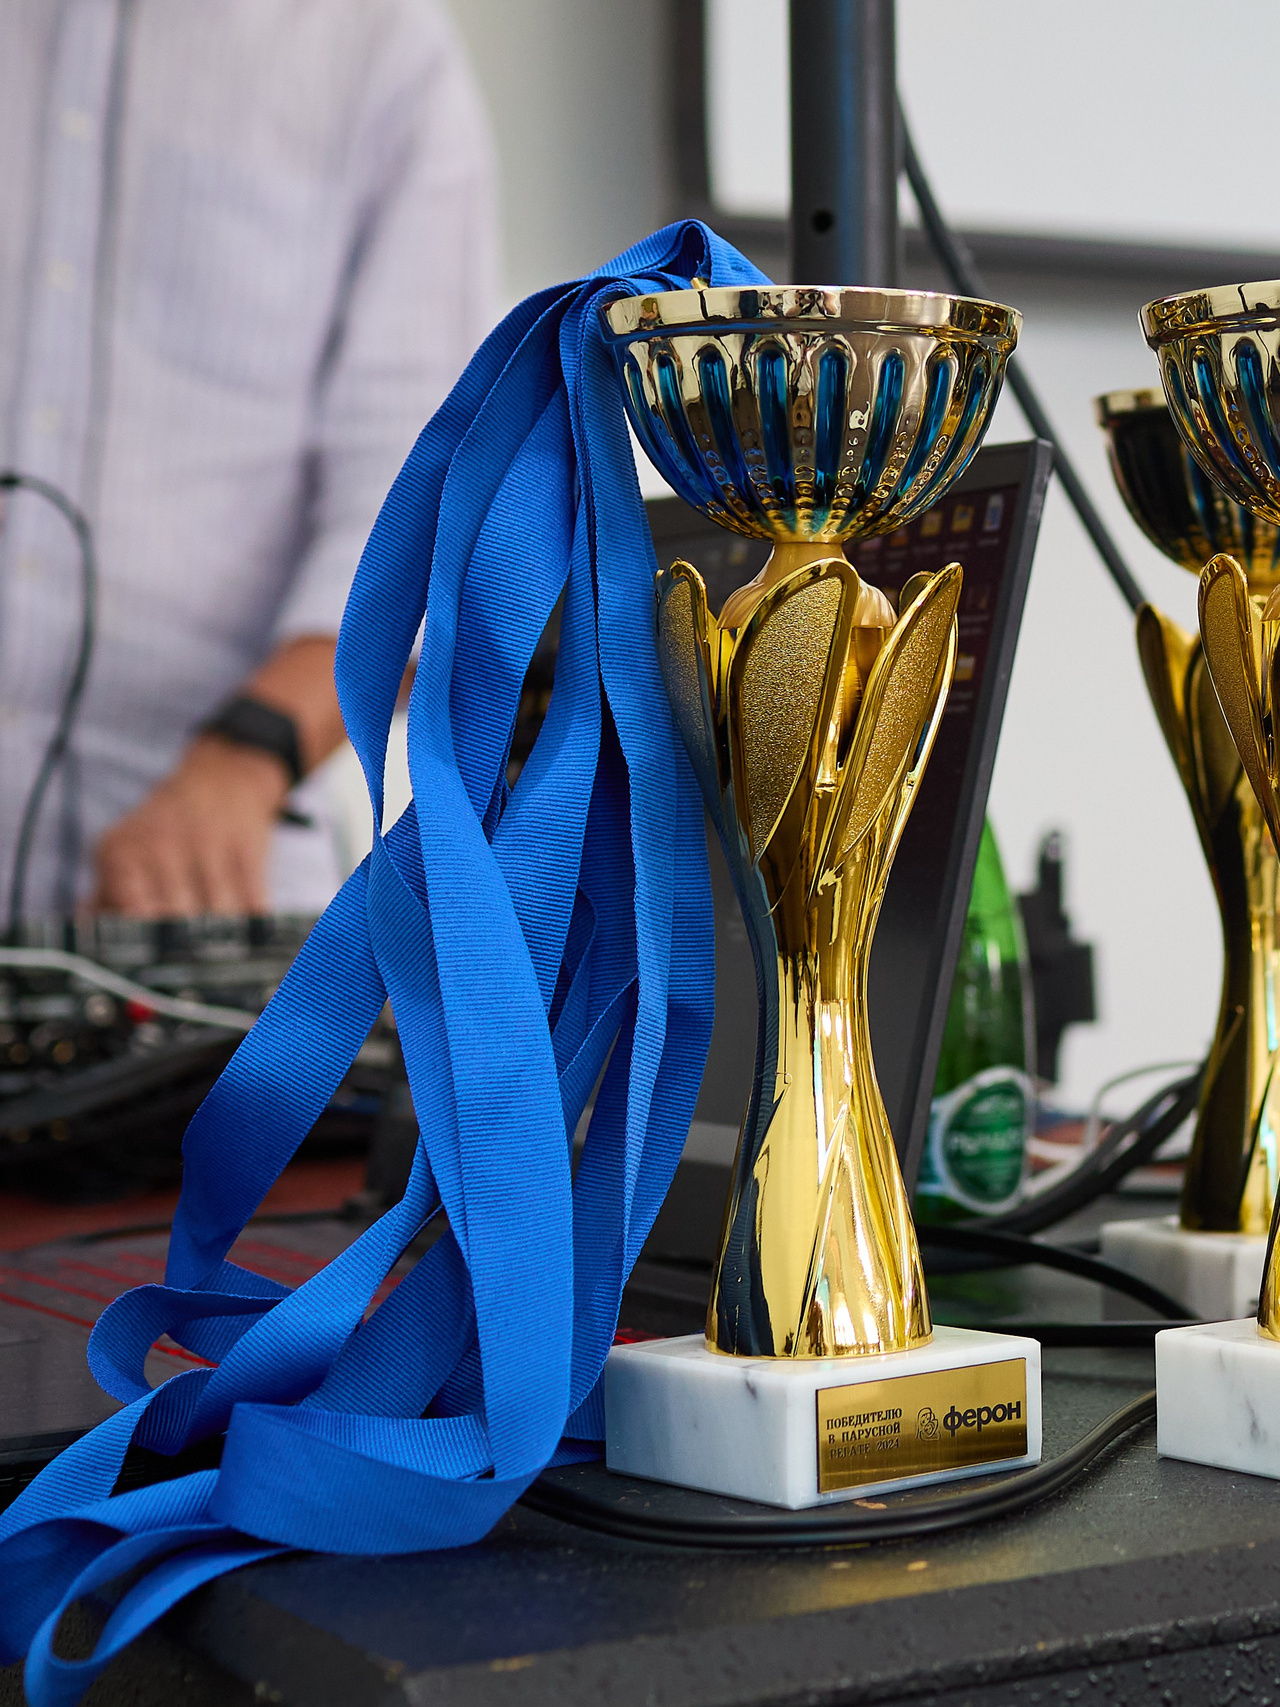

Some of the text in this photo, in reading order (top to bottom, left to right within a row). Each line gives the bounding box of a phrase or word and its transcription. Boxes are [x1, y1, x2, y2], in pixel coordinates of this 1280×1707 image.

[826, 1407, 902, 1430] ПОБЕДИТЕЛЮ
[943, 1400, 1021, 1437] ферон
[828, 1422, 901, 1444] В ПАРУСНОЙ
[829, 1437, 900, 1460] РЕГАТЕ 2024
